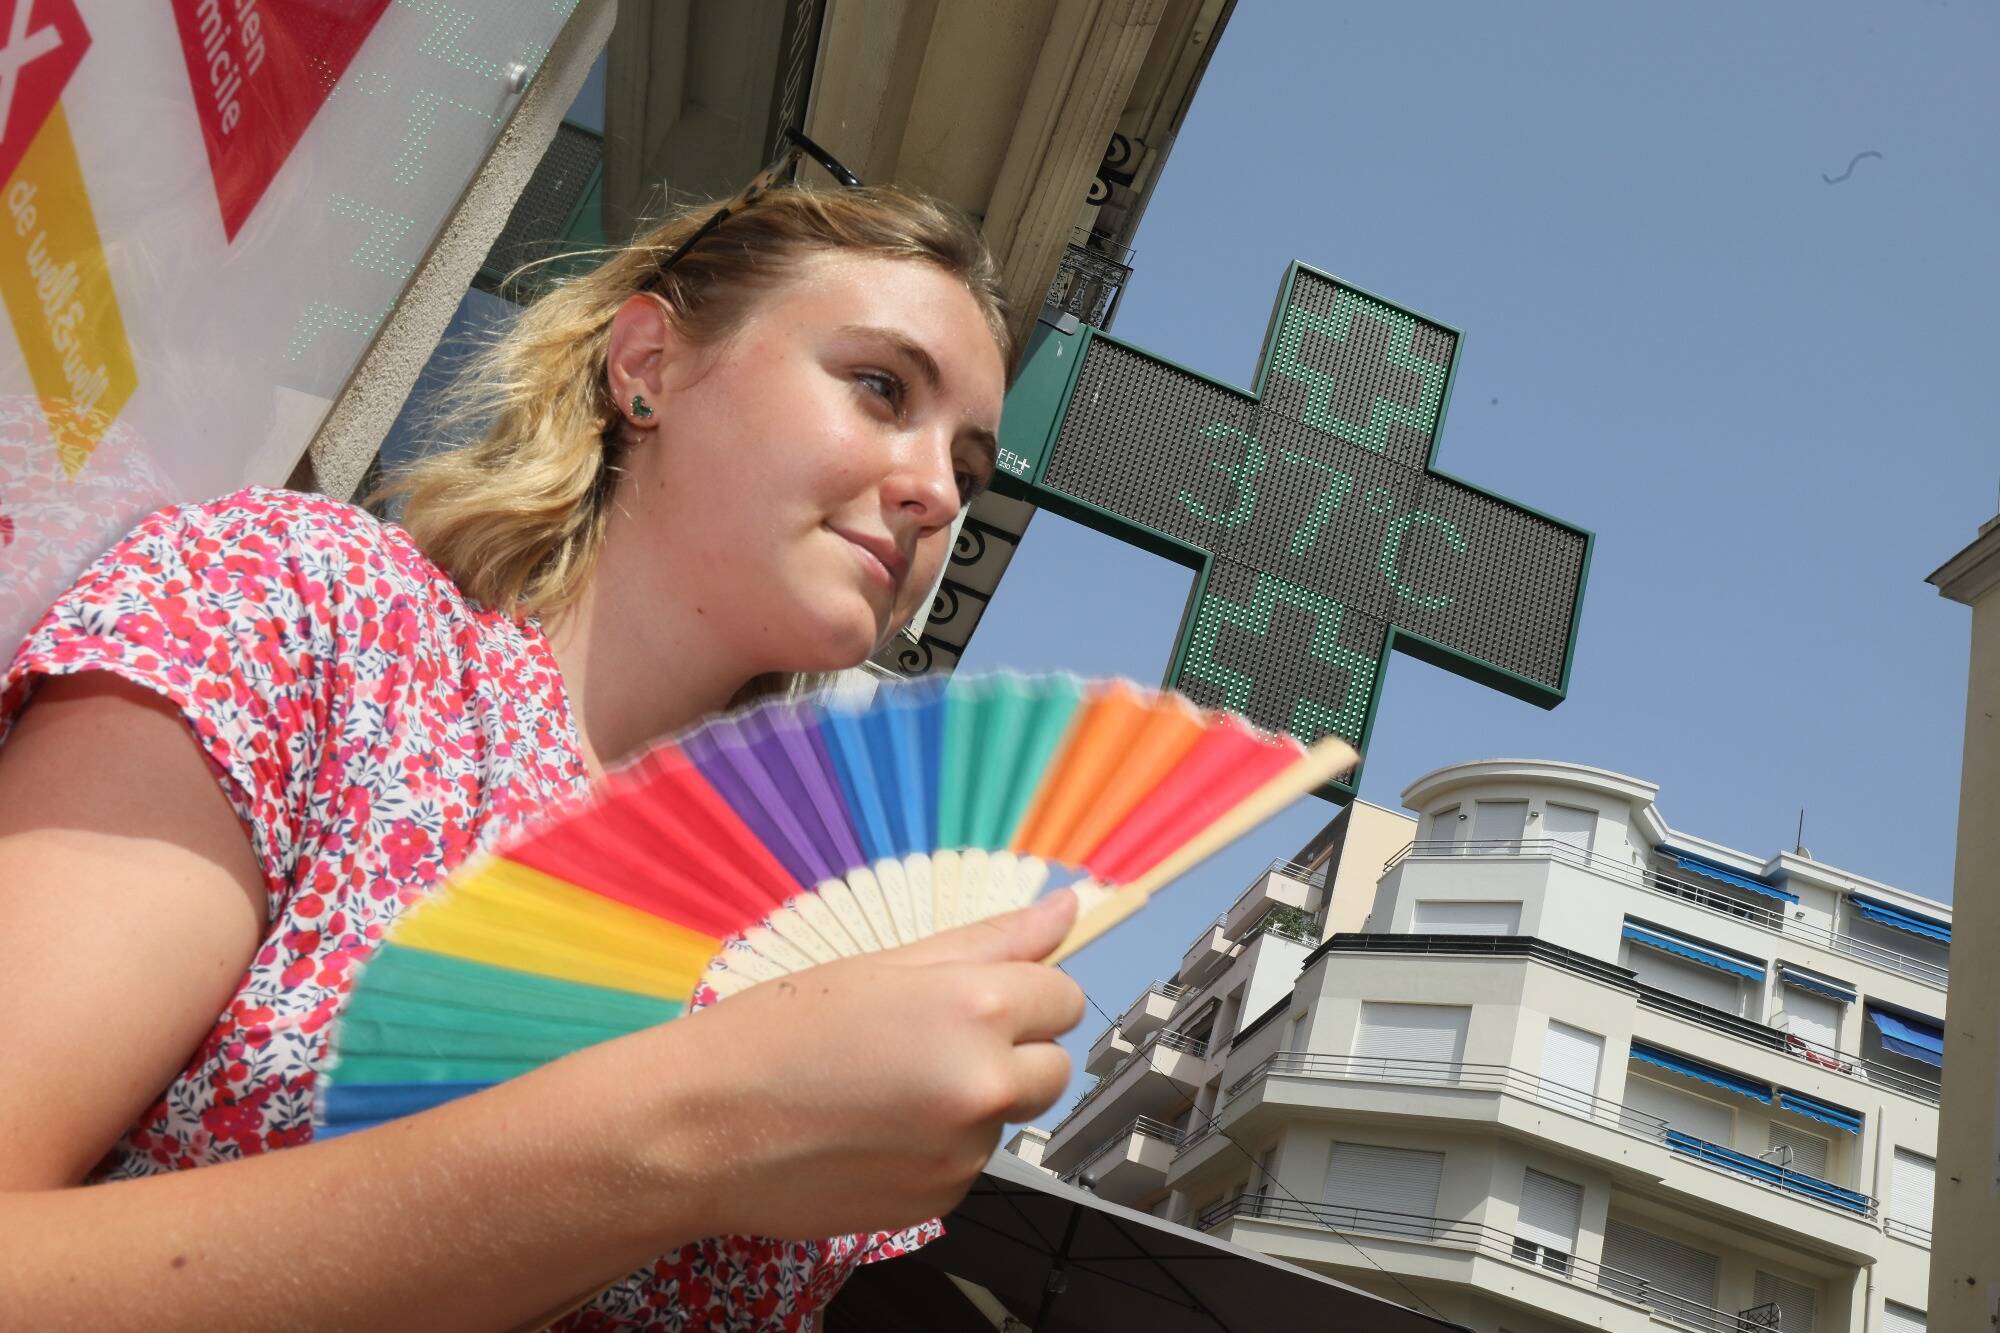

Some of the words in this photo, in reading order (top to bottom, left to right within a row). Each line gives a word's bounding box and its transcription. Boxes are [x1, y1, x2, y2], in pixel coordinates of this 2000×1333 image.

[235, 0, 266, 76] ien
[8, 180, 37, 237] de
[1011, 466, 1023, 476] 230
